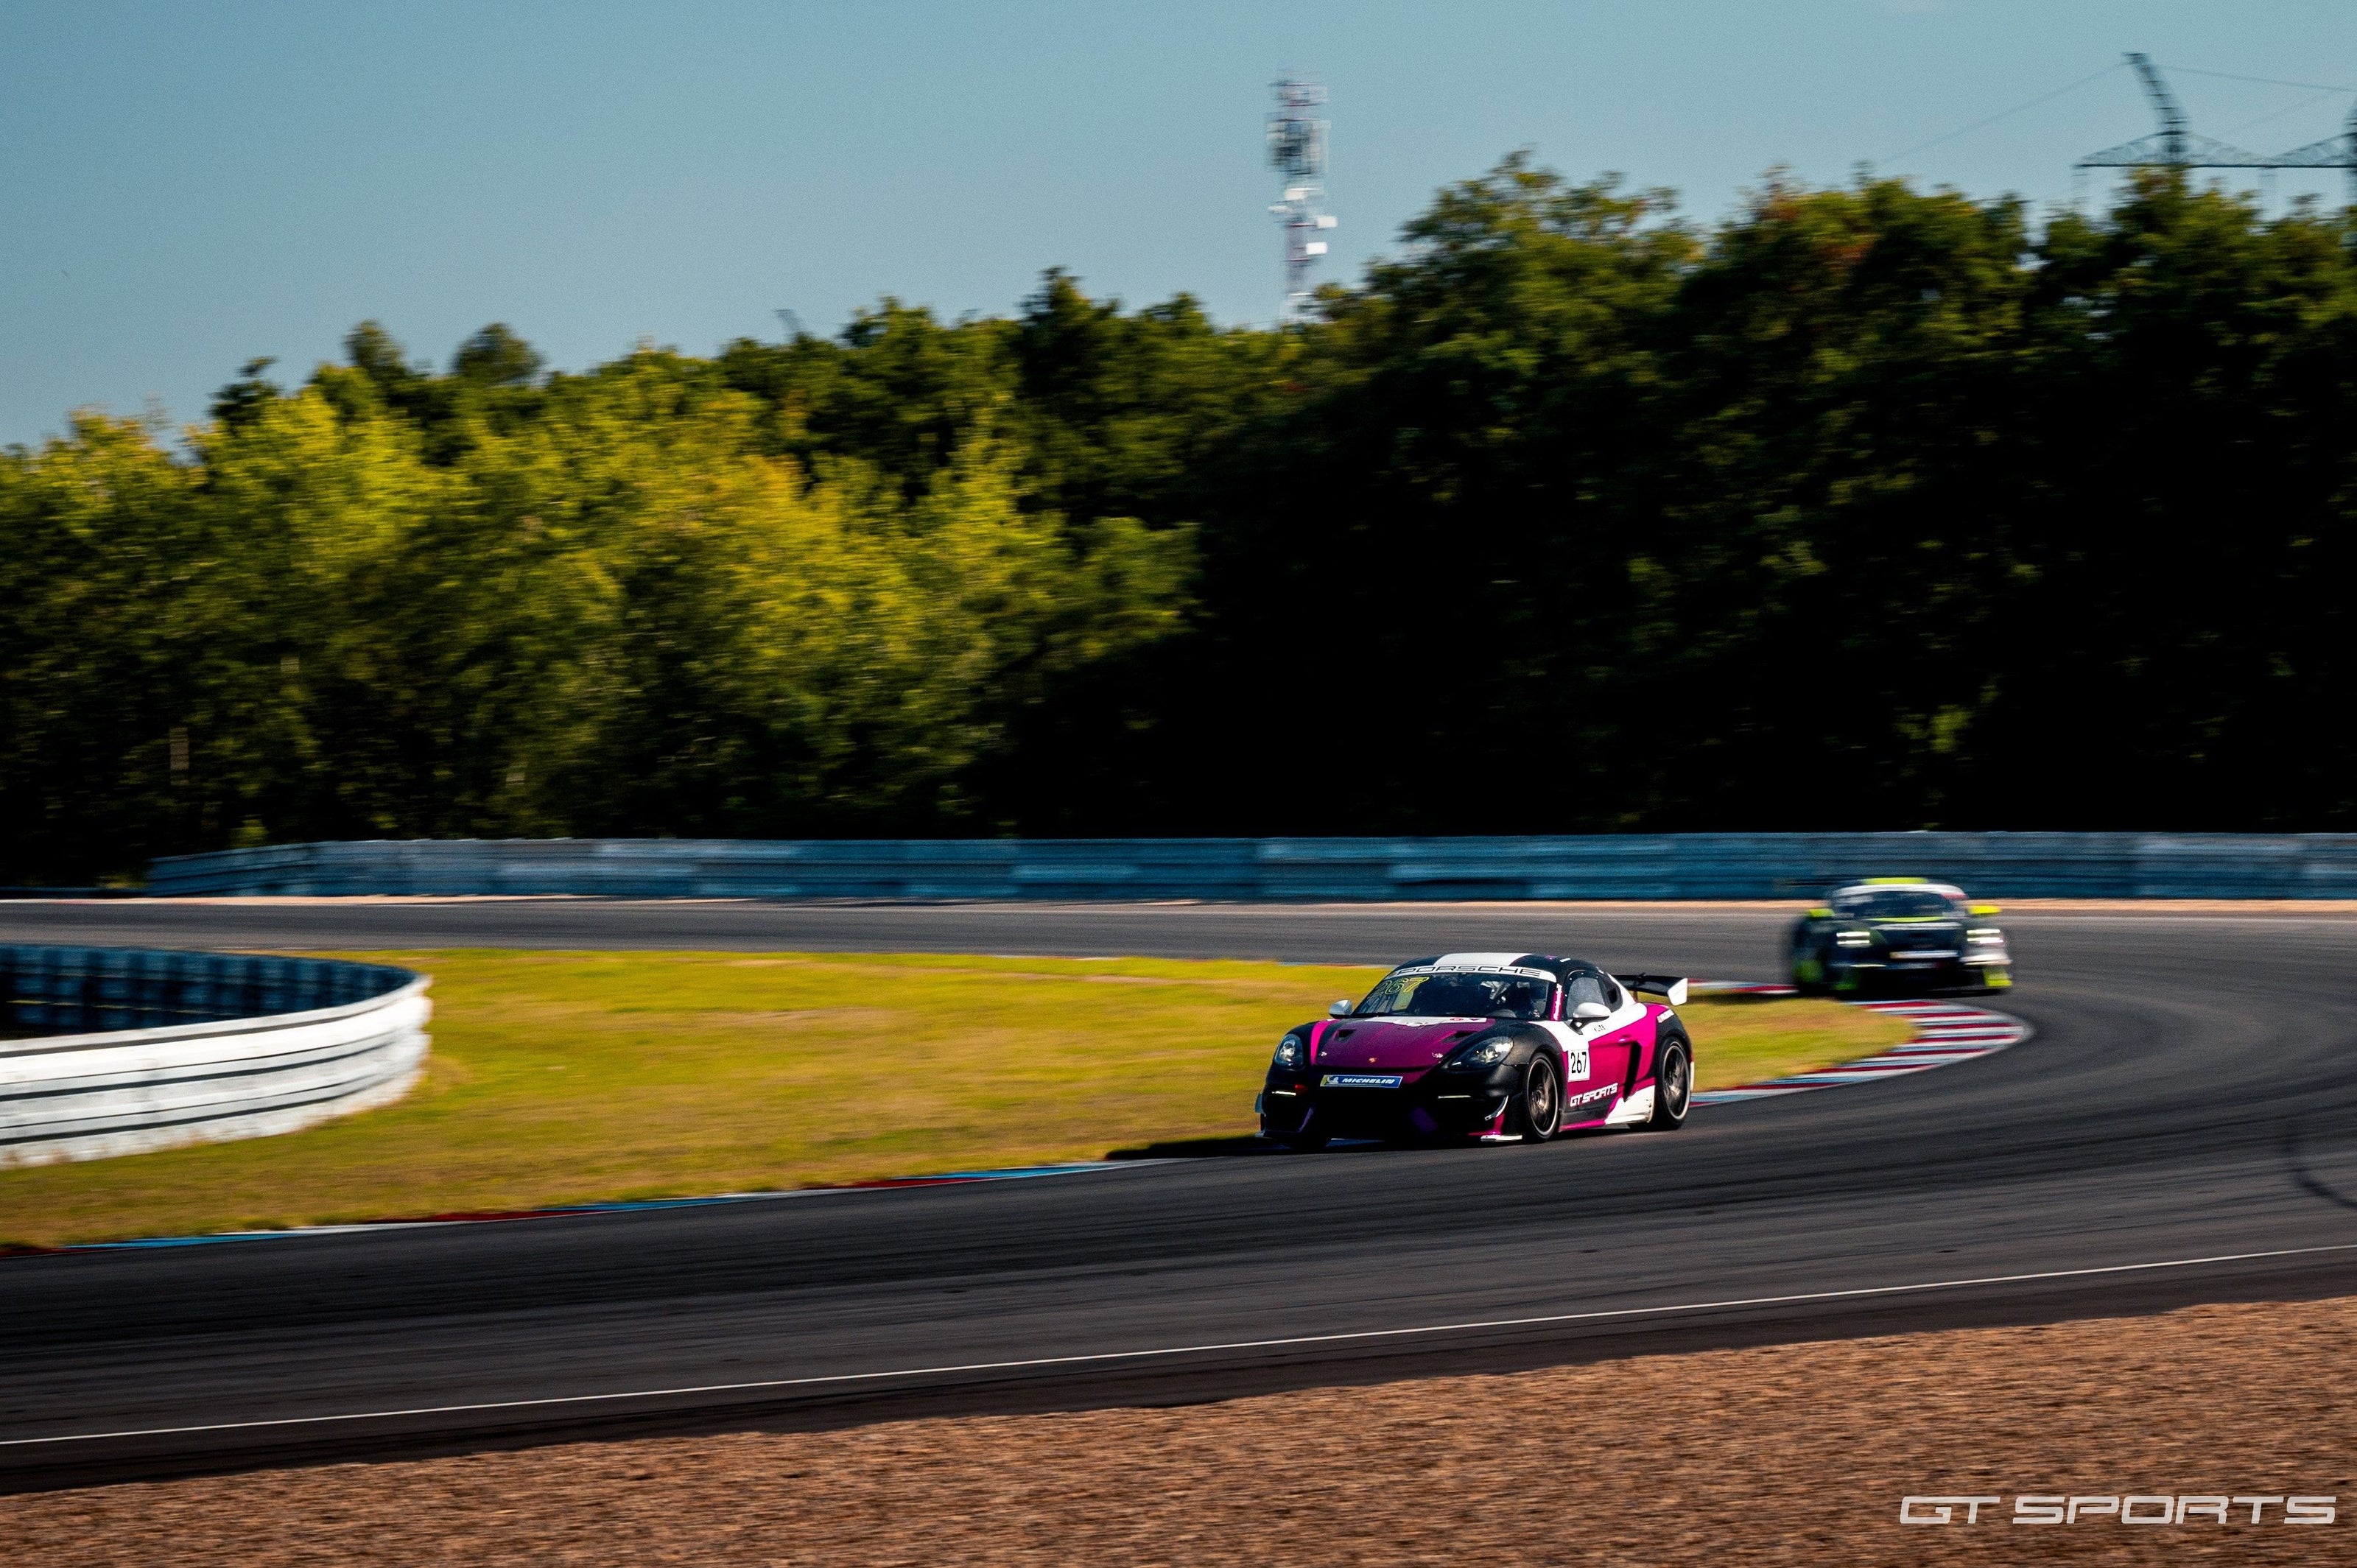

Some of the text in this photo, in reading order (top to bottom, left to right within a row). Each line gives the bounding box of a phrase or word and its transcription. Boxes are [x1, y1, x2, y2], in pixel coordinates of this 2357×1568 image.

[1397, 966, 1541, 977] PORSCHE
[1375, 977, 1430, 995] 267
[1570, 1051, 1587, 1074] 267
[1570, 1082, 1619, 1108] GT SPORTS
